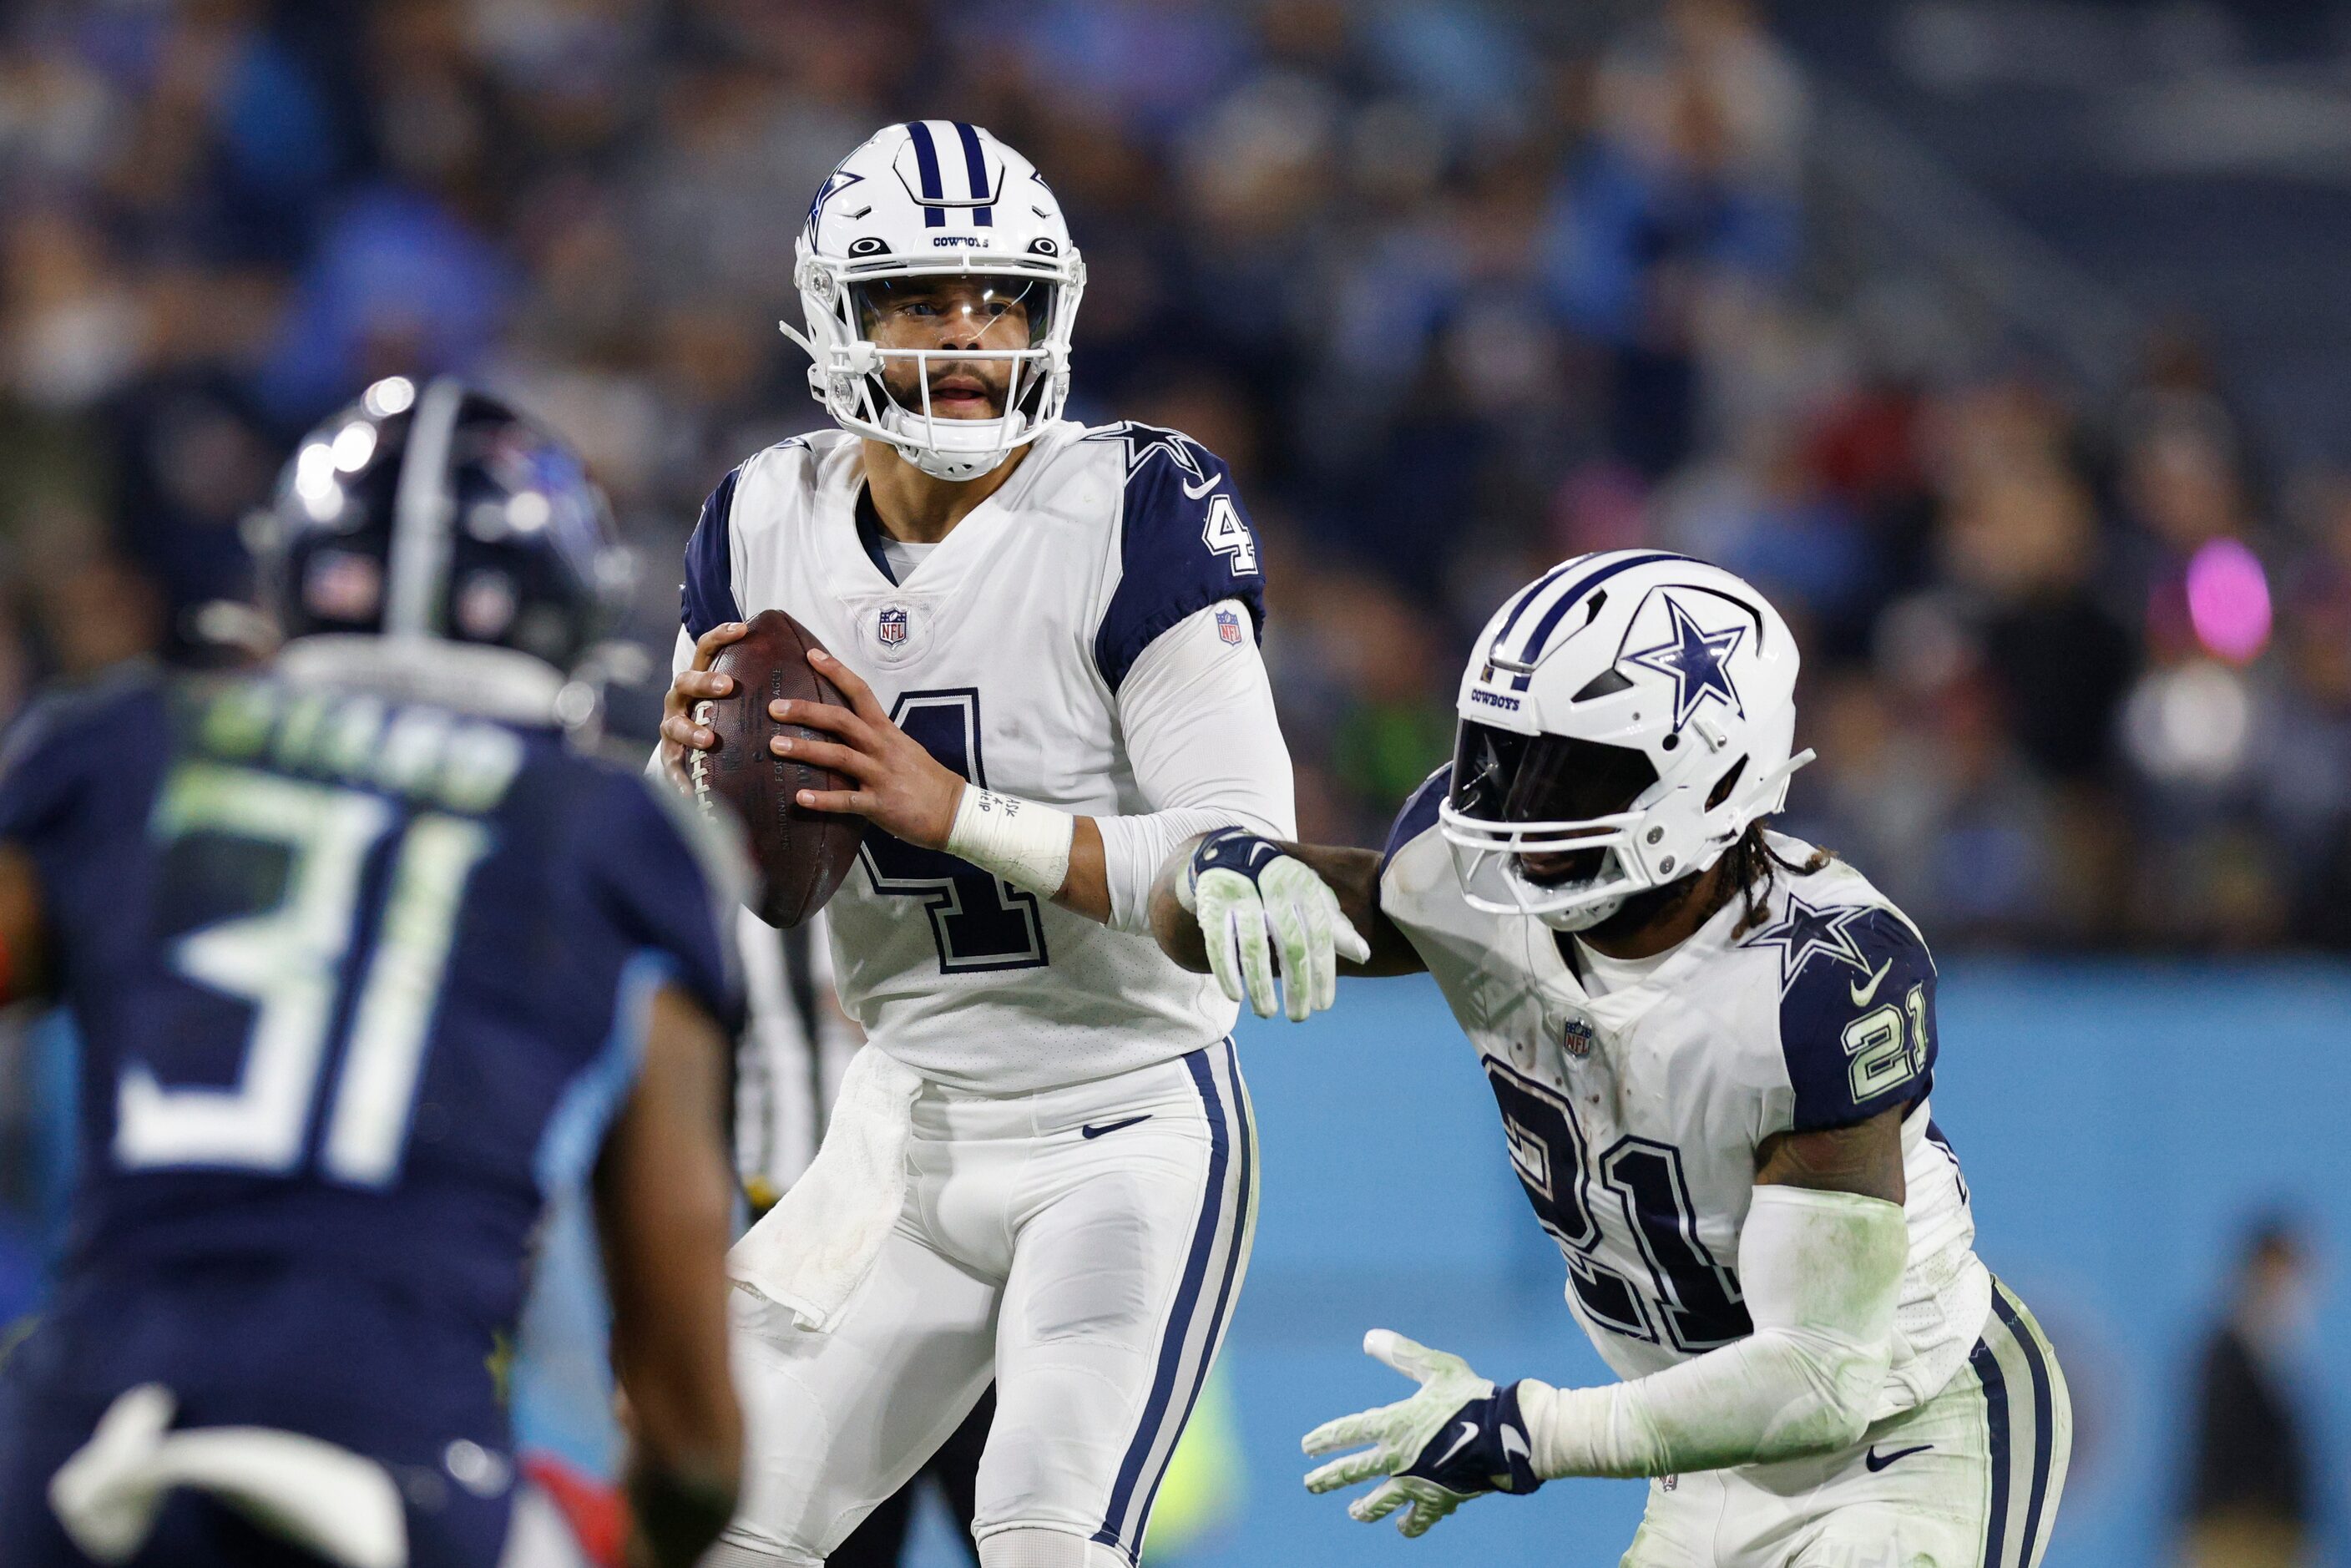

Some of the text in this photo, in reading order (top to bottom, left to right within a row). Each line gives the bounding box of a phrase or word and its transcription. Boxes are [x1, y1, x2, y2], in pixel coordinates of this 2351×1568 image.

[1201, 494, 1259, 577] 4
[882, 624, 904, 641] NFL
[1220, 625, 1241, 642] NFL
[771, 668, 781, 700] AGUE
[1471, 688, 1520, 711] COWBOYS
[776, 790, 791, 851] NATIONAL
[1005, 796, 1021, 817] ASK
[111, 763, 492, 1191] 31
[1566, 1034, 1590, 1055] NFL
[1840, 981, 1929, 1105] 21
[1481, 1053, 1755, 1353] 21
